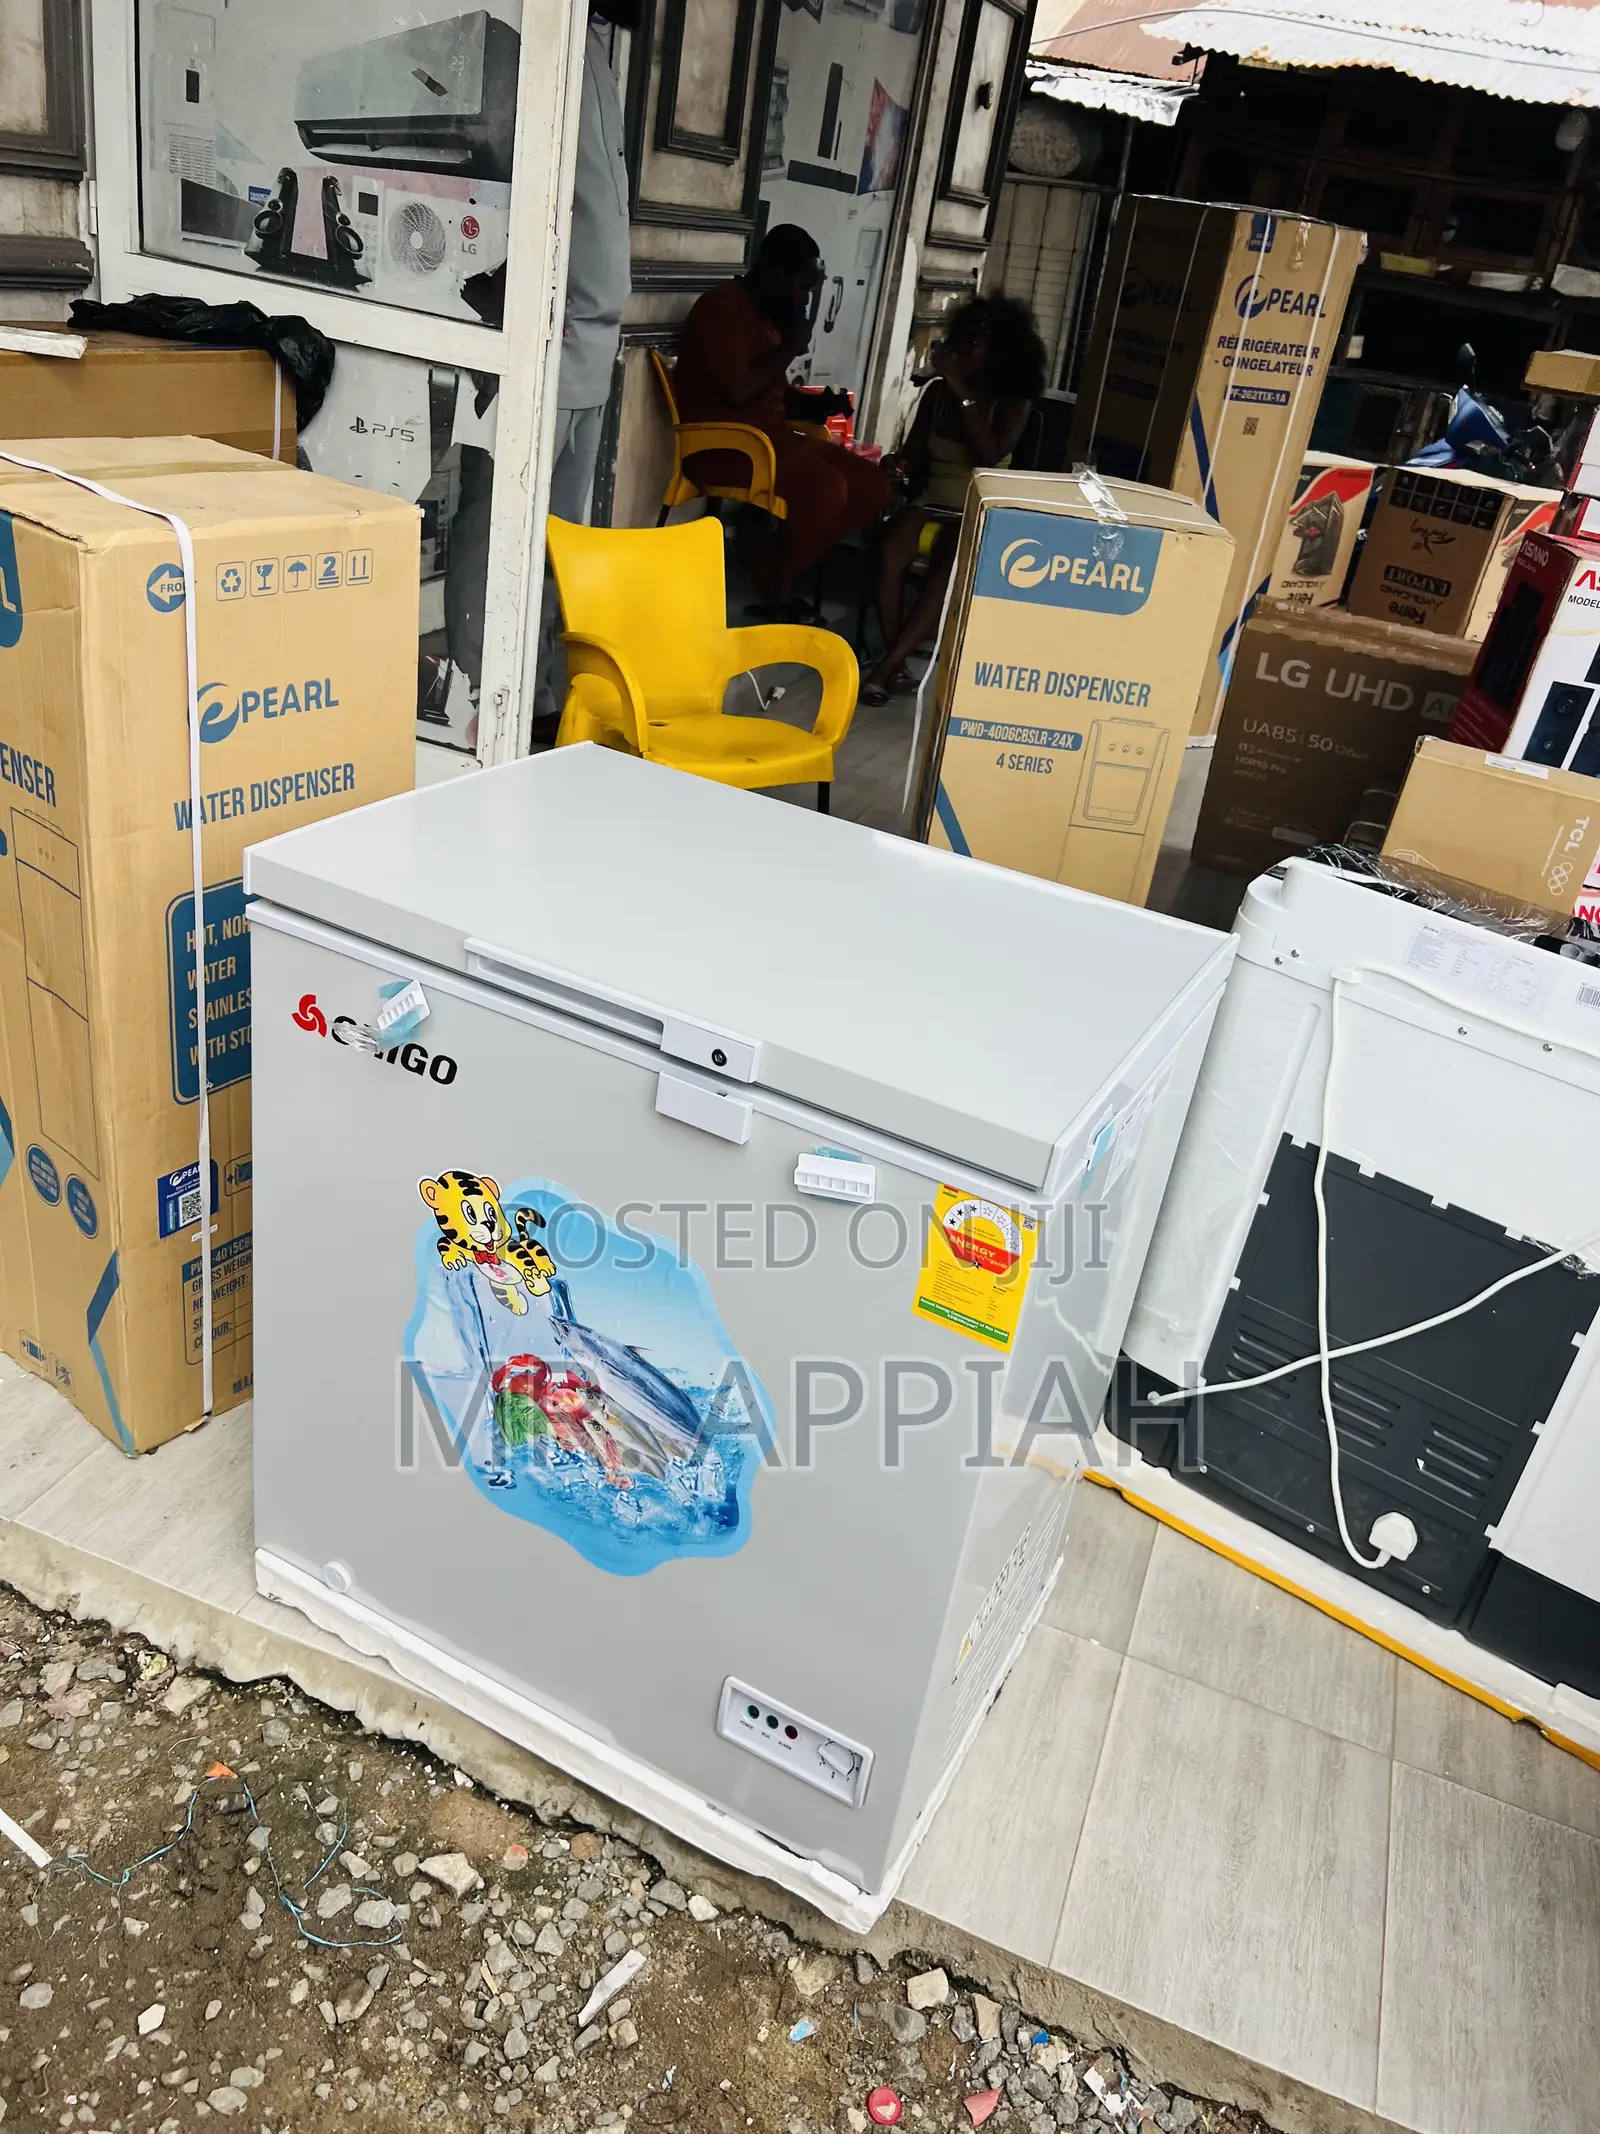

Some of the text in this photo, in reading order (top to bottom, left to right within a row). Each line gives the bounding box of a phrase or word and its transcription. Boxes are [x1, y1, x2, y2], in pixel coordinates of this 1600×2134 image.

[1267, 288, 1327, 319] PEARL
[372, 423, 415, 443] PS5
[1049, 554, 1145, 594] PEARL
[975, 660, 1152, 709] WATER DISPENSER
[1255, 652, 1312, 689] LG
[1324, 666, 1414, 712] UHD
[241, 677, 340, 724] PEARL
[1243, 717, 1298, 744] UA85
[996, 754, 1054, 775] 4 SERIES
[174, 762, 356, 832] WATER DISPENSER
[1564, 815, 1590, 853] TCL
[186, 923, 218, 953] HT,
[188, 987, 252, 1030] SAINLES
[189, 1034, 226, 1067] WTH
[182, 1165, 200, 1180] PEA
[192, 1268, 222, 1293] GRSS
[194, 1320, 232, 1350] COOUR:
